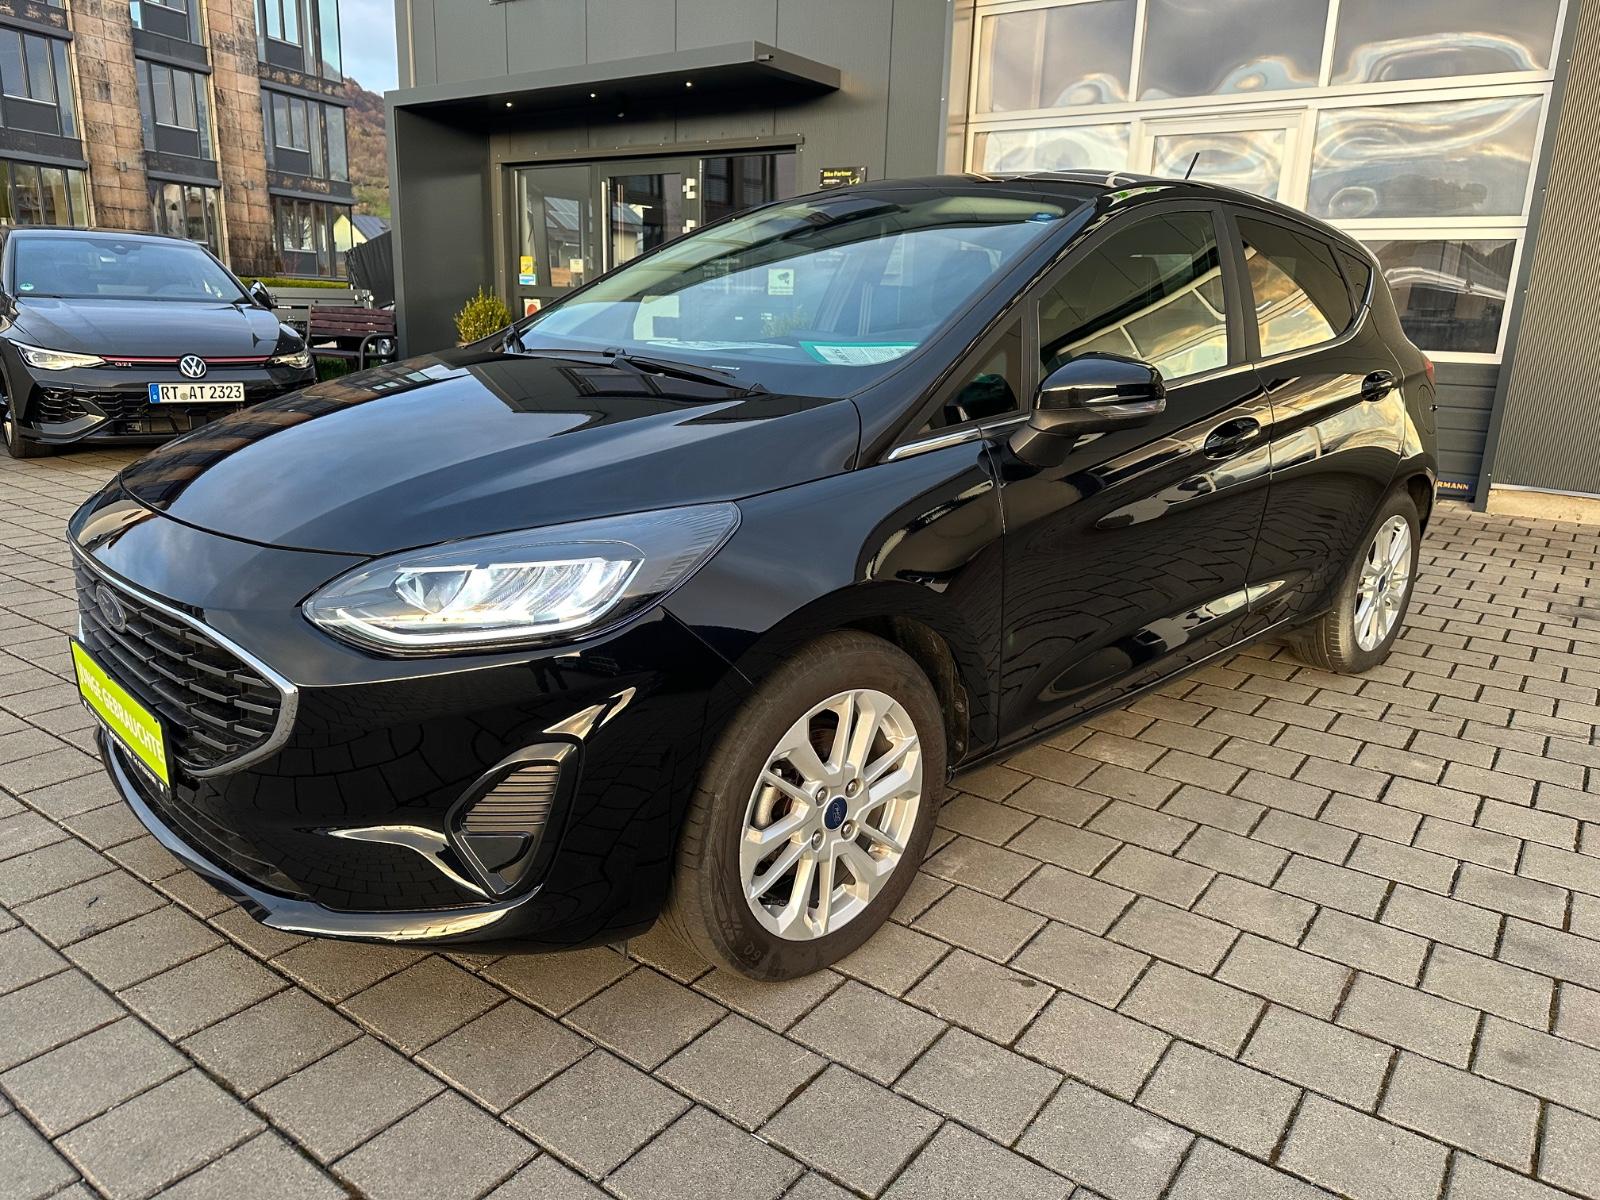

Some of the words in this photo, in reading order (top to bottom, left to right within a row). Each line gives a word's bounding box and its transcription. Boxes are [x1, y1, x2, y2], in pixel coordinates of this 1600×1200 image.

[161, 386, 179, 400] RT
[189, 386, 205, 400] AT
[209, 385, 242, 399] 2323
[101, 685, 165, 764] GEBRAUCHTE
